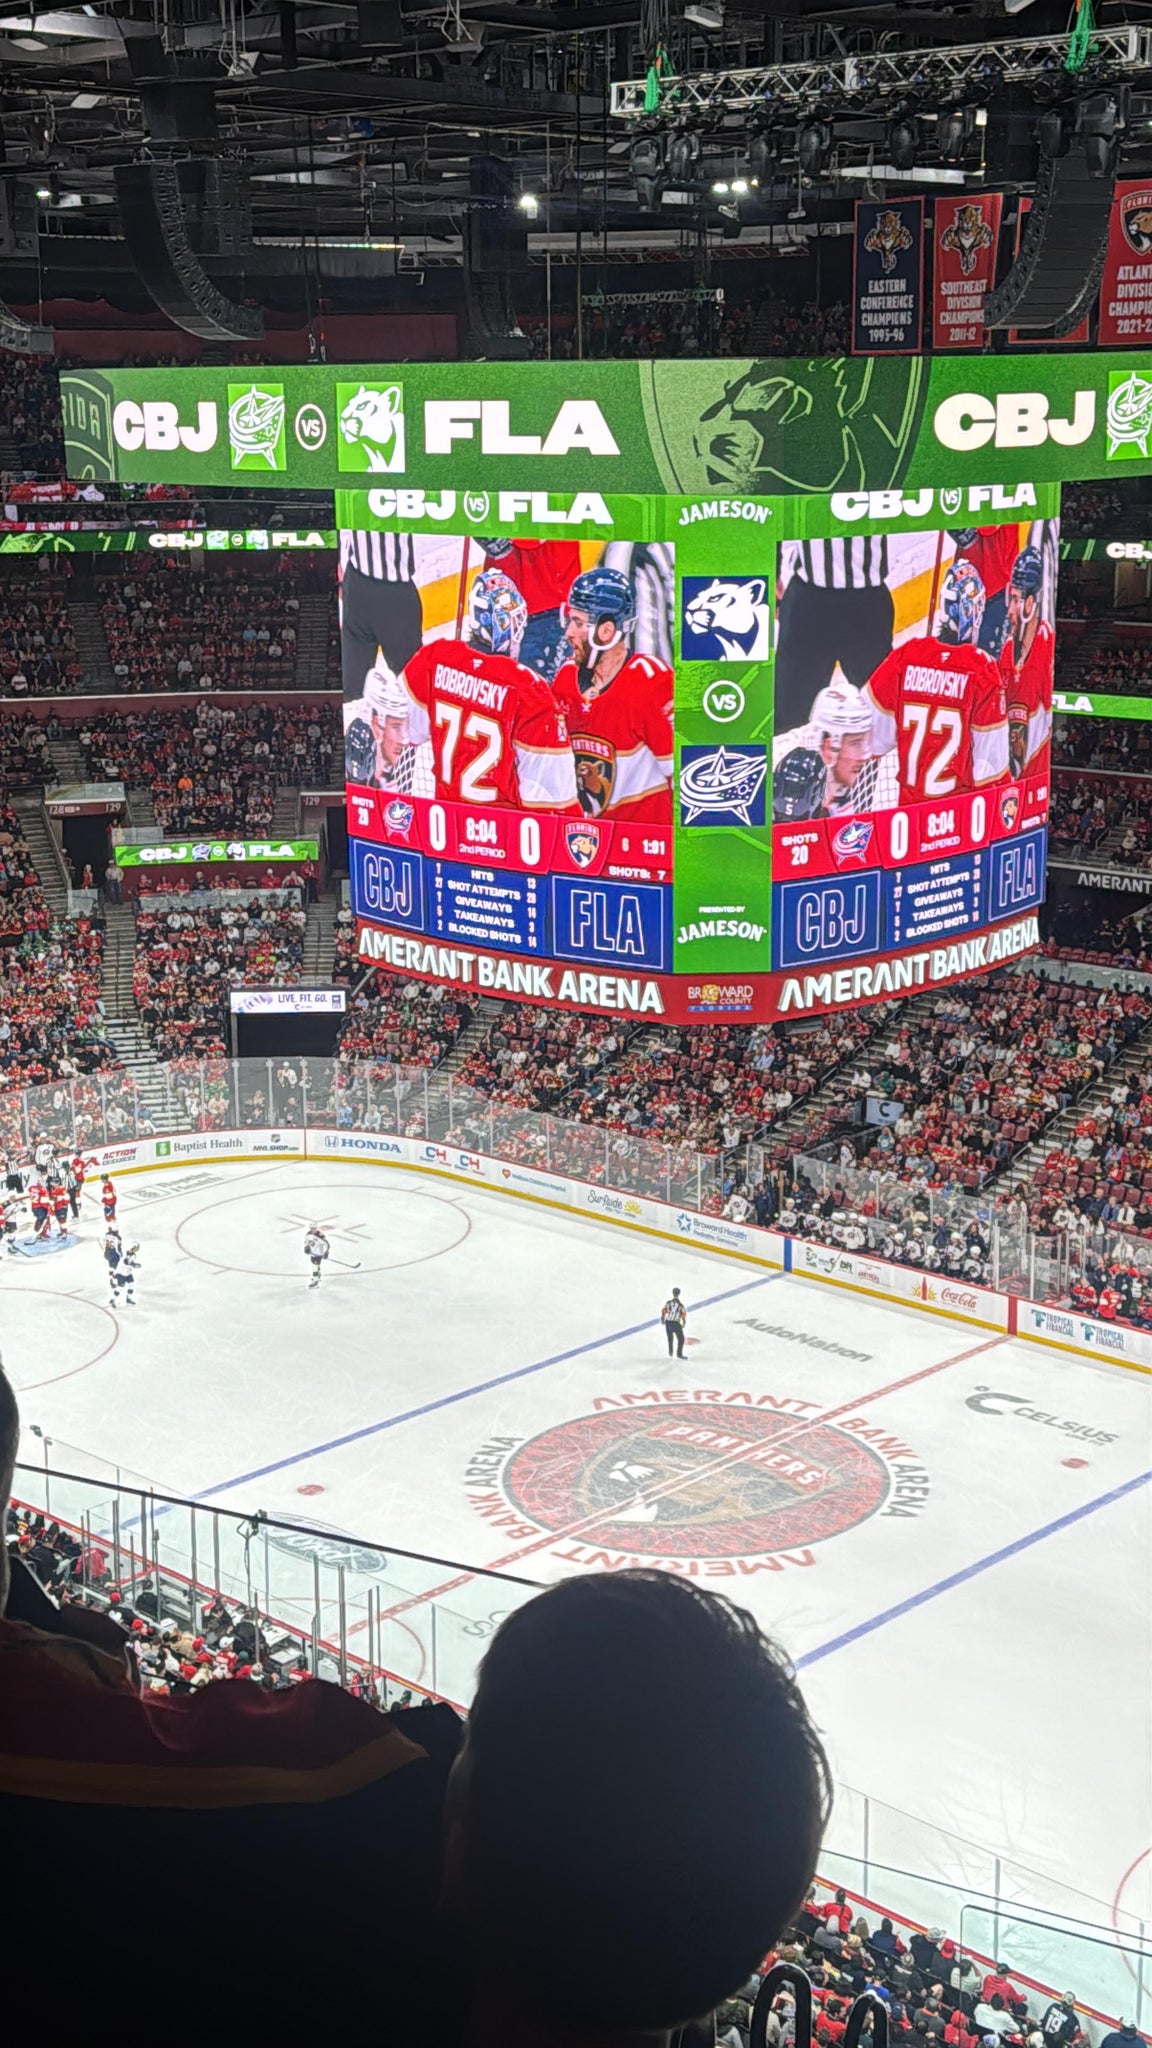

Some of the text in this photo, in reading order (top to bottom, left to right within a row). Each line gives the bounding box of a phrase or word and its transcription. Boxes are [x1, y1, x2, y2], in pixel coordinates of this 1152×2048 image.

[868, 279, 907, 293] EASTERN
[941, 279, 988, 295] SOUTHEAST
[860, 295, 914, 310] CONFERENCE
[946, 295, 982, 309] DIVISION
[861, 311, 913, 326] CHAMPIONS
[940, 309, 985, 325] CHAMPIONS
[868, 328, 905, 342] 1995-96
[113, 400, 321, 452] CBJ VS
[424, 400, 621, 456] FLA
[933, 390, 1096, 451] CBJ
[368, 489, 457, 520] CBJ
[498, 491, 614, 525] FLA
[678, 499, 769, 526] JAMESON
[830, 488, 934, 521] CBJ
[968, 483, 1036, 511] FLA
[148, 532, 325, 548] CBJ FLA
[434, 664, 509, 712] BOBROVSKY
[904, 664, 970, 700] BOBROVSKY
[711, 693, 737, 711] VS
[435, 701, 502, 801] 72
[903, 704, 964, 797] 72
[429, 804, 447, 851] 0
[927, 809, 955, 837] 8:04
[971, 795, 986, 842] 0
[465, 817, 498, 844] 8:04
[520, 817, 540, 866] 0
[781, 832, 819, 846] SHOTS
[891, 812, 909, 860] 0
[139, 845, 295, 861] CBJ FLA
[791, 845, 809, 866] 20
[471, 869, 494, 882] HITS
[930, 862, 950, 875] HITS
[999, 843, 1036, 907] FLA
[363, 853, 413, 917] CBJ
[447, 880, 471, 892] SHOT
[471, 885, 521, 900] ATTEMPTS
[907, 881, 930, 894] SHOT
[930, 872, 970, 889] ATTEMPTS
[1077, 872, 1152, 894] AMERANT
[455, 896, 513, 913] GIVEAWAYS
[914, 887, 964, 907] GIVEAWAYS
[454, 909, 515, 928] TAKEAWAYS
[571, 889, 645, 955] FLA
[797, 885, 866, 951] CBJ
[912, 901, 964, 921] TAKEAWAYS
[448, 922, 488, 937] BLOCKED
[489, 930, 522, 944] SHOTS
[677, 919, 764, 944] JAMESON
[906, 921, 943, 938] BLOCKED
[943, 914, 969, 928] SHOTS
[359, 927, 665, 1014] AMERANT BANK ARENA
[777, 916, 1040, 1012] AMERANT BANK ARENA
[720, 997, 752, 1005] COUNTY
[103, 1147, 137, 1161] ACTION
[173, 1138, 243, 1153] Baptist Health
[341, 1138, 402, 1154] HONDA
[587, 1189, 623, 1210] Surfside
[693, 1218, 747, 1240] Broward Health
[1046, 1322, 1075, 1337] FINANCIAL
[1047, 1313, 1073, 1328] TROPICAL
[732, 1318, 873, 1362] AutoNation
[1096, 1326, 1123, 1341] TROPICAL
[1096, 1335, 1125, 1351] FINANCIAL
[592, 1389, 822, 1413] AMERANT
[1013, 1407, 1120, 1443] CELSIUS
[463, 1437, 525, 1488] ARENA
[663, 1426, 822, 1485] PANTHERS
[836, 1418, 930, 1518] BANK ARENA
[466, 1491, 541, 1540] BANK
[1045, 2013, 1063, 2034] 19
